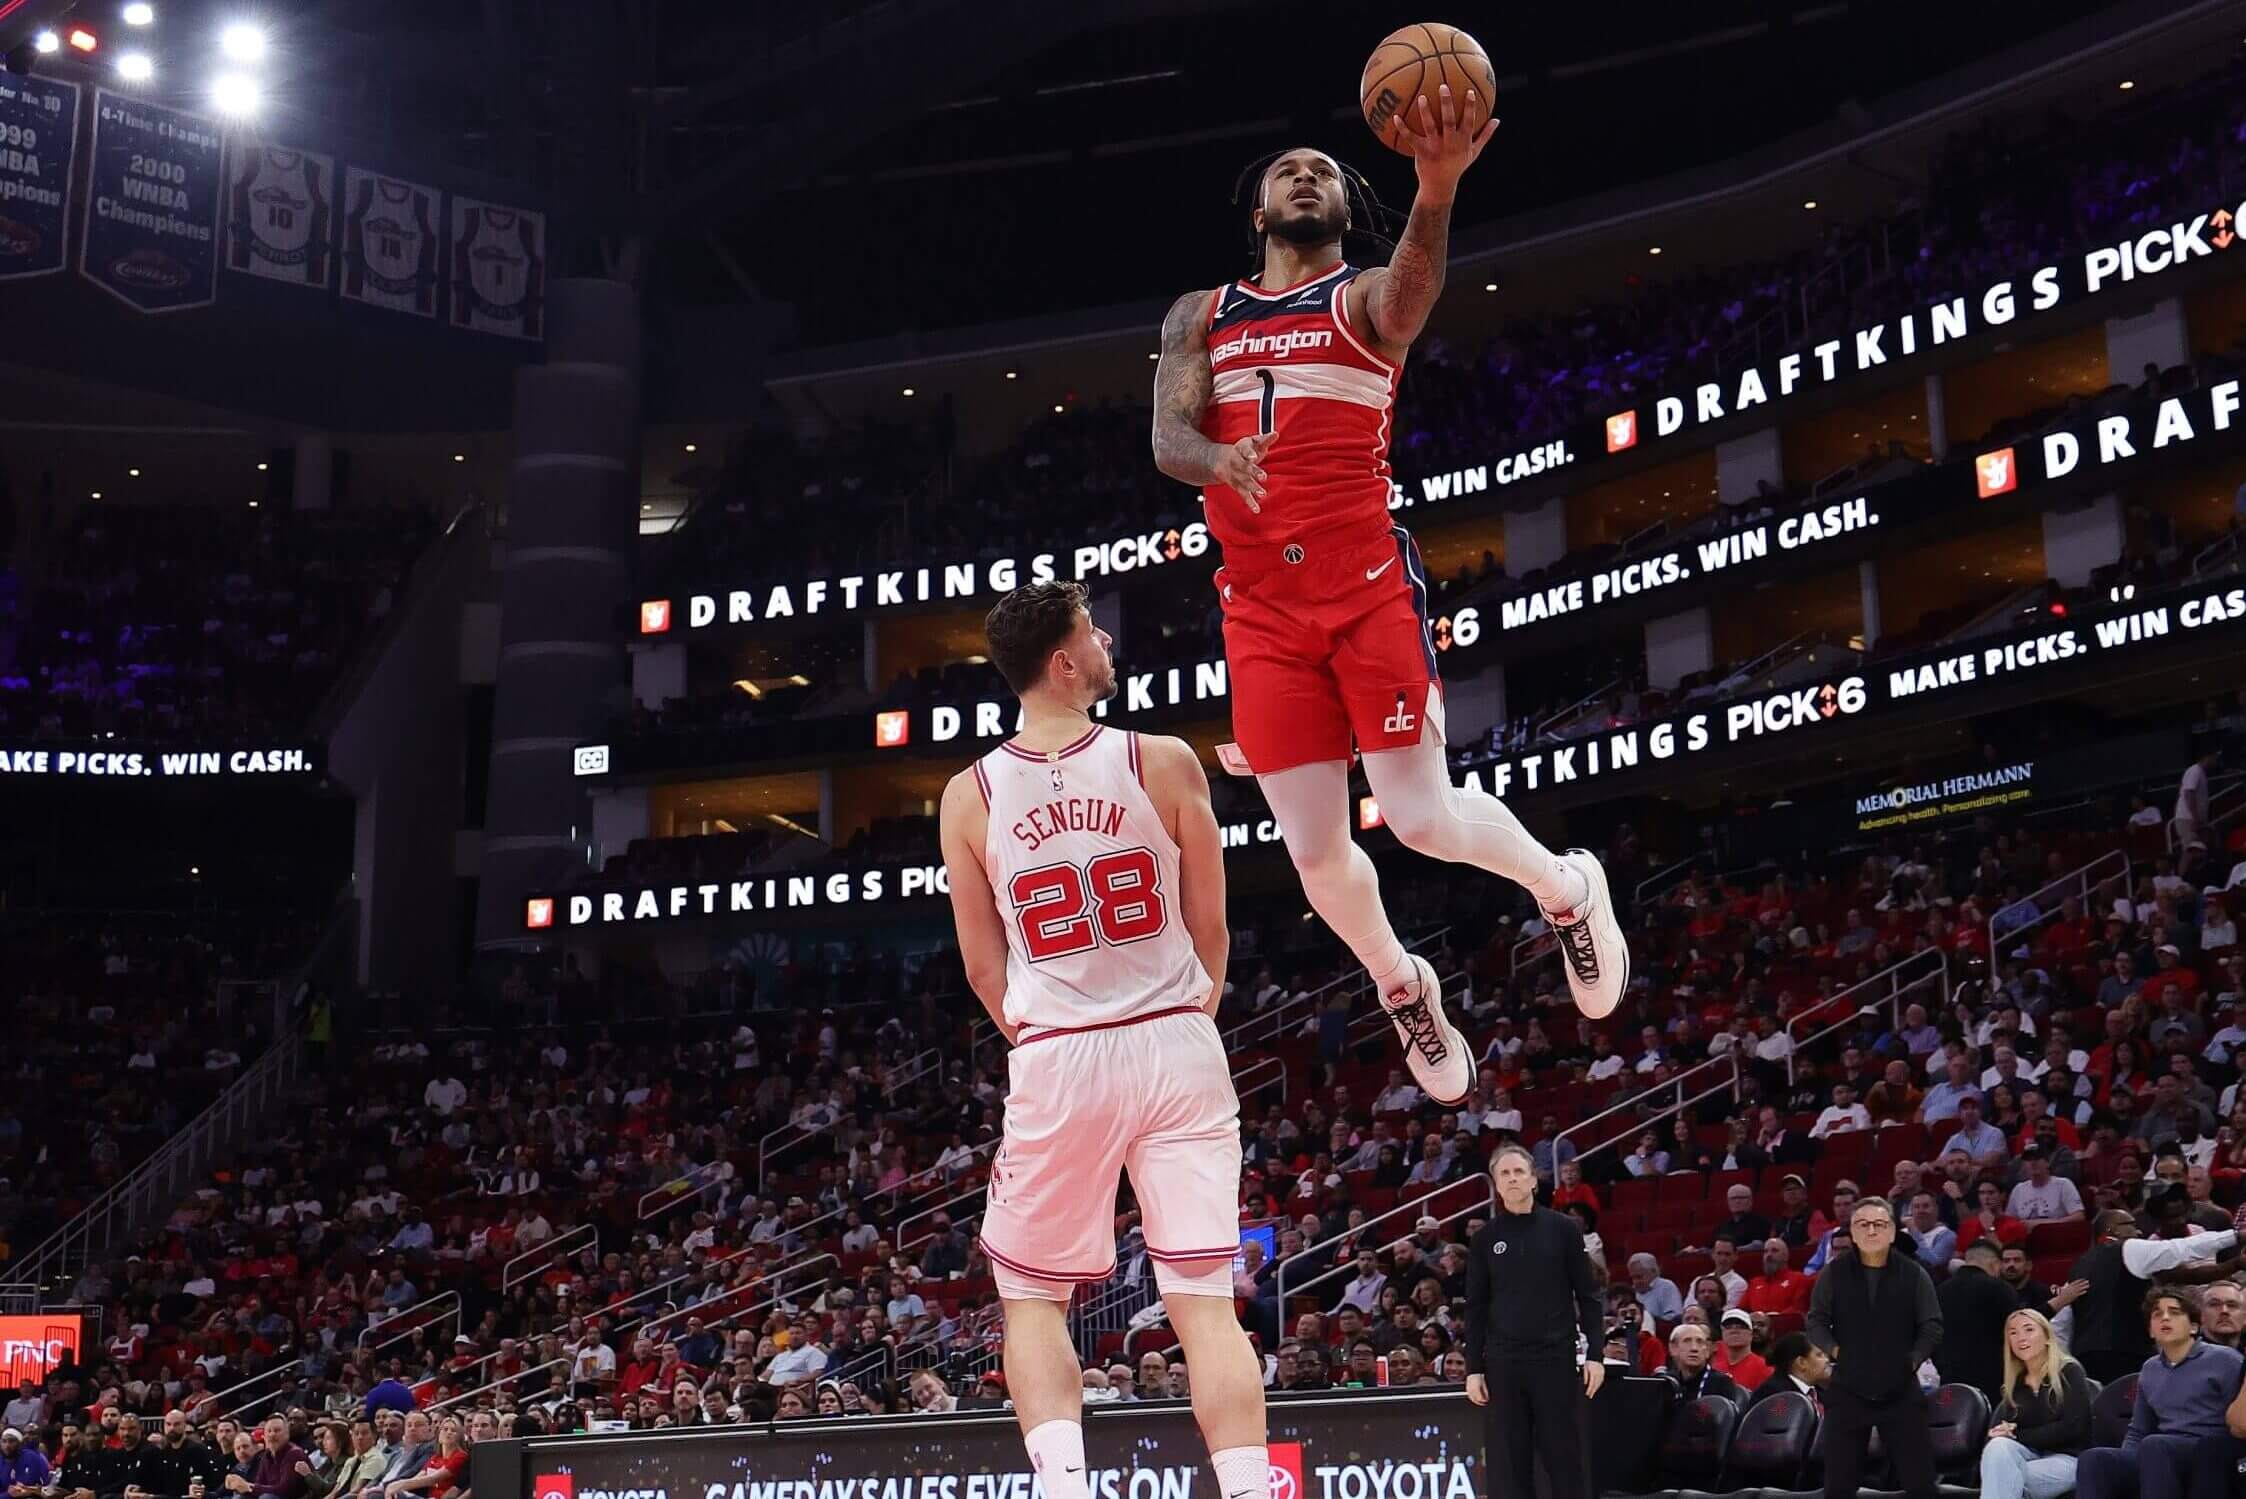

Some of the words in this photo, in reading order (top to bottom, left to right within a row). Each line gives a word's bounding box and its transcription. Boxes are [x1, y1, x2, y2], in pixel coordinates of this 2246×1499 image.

[0, 178, 61, 206] pions
[123, 176, 189, 211] WNBA
[130, 154, 185, 184] 2000
[97, 196, 210, 240] Champions
[1657, 267, 2060, 435] DRAFTKINGS
[1255, 369, 1276, 435] 1
[2044, 381, 2240, 479] DRAF
[1422, 466, 1487, 502] WIN
[1496, 440, 1575, 484] CASH.
[1502, 581, 1583, 630] MAKE
[1593, 554, 1690, 604] PICKS.
[1698, 527, 1767, 572] WIN
[1778, 498, 1879, 549] CASH.
[690, 554, 1057, 628] DRAFTKINGS
[1890, 655, 1976, 698] MAKE
[1985, 631, 2087, 676] PICKS.
[2095, 608, 2169, 649] WIN
[58, 752, 152, 776] PICKS.
[162, 752, 221, 775] WIN
[231, 750, 312, 774] CASH.
[1856, 786, 1941, 814] MEMORIAL
[1941, 763, 2033, 797] HERMANN
[1012, 798, 1127, 851] SENGUN
[570, 870, 883, 925] DRAFTKINGS
[1008, 846, 1169, 963] 28
[4, 1339, 64, 1365] PNC
[1128, 1465, 1192, 1499] ON
[1313, 1462, 1477, 1499] TOYOTA
